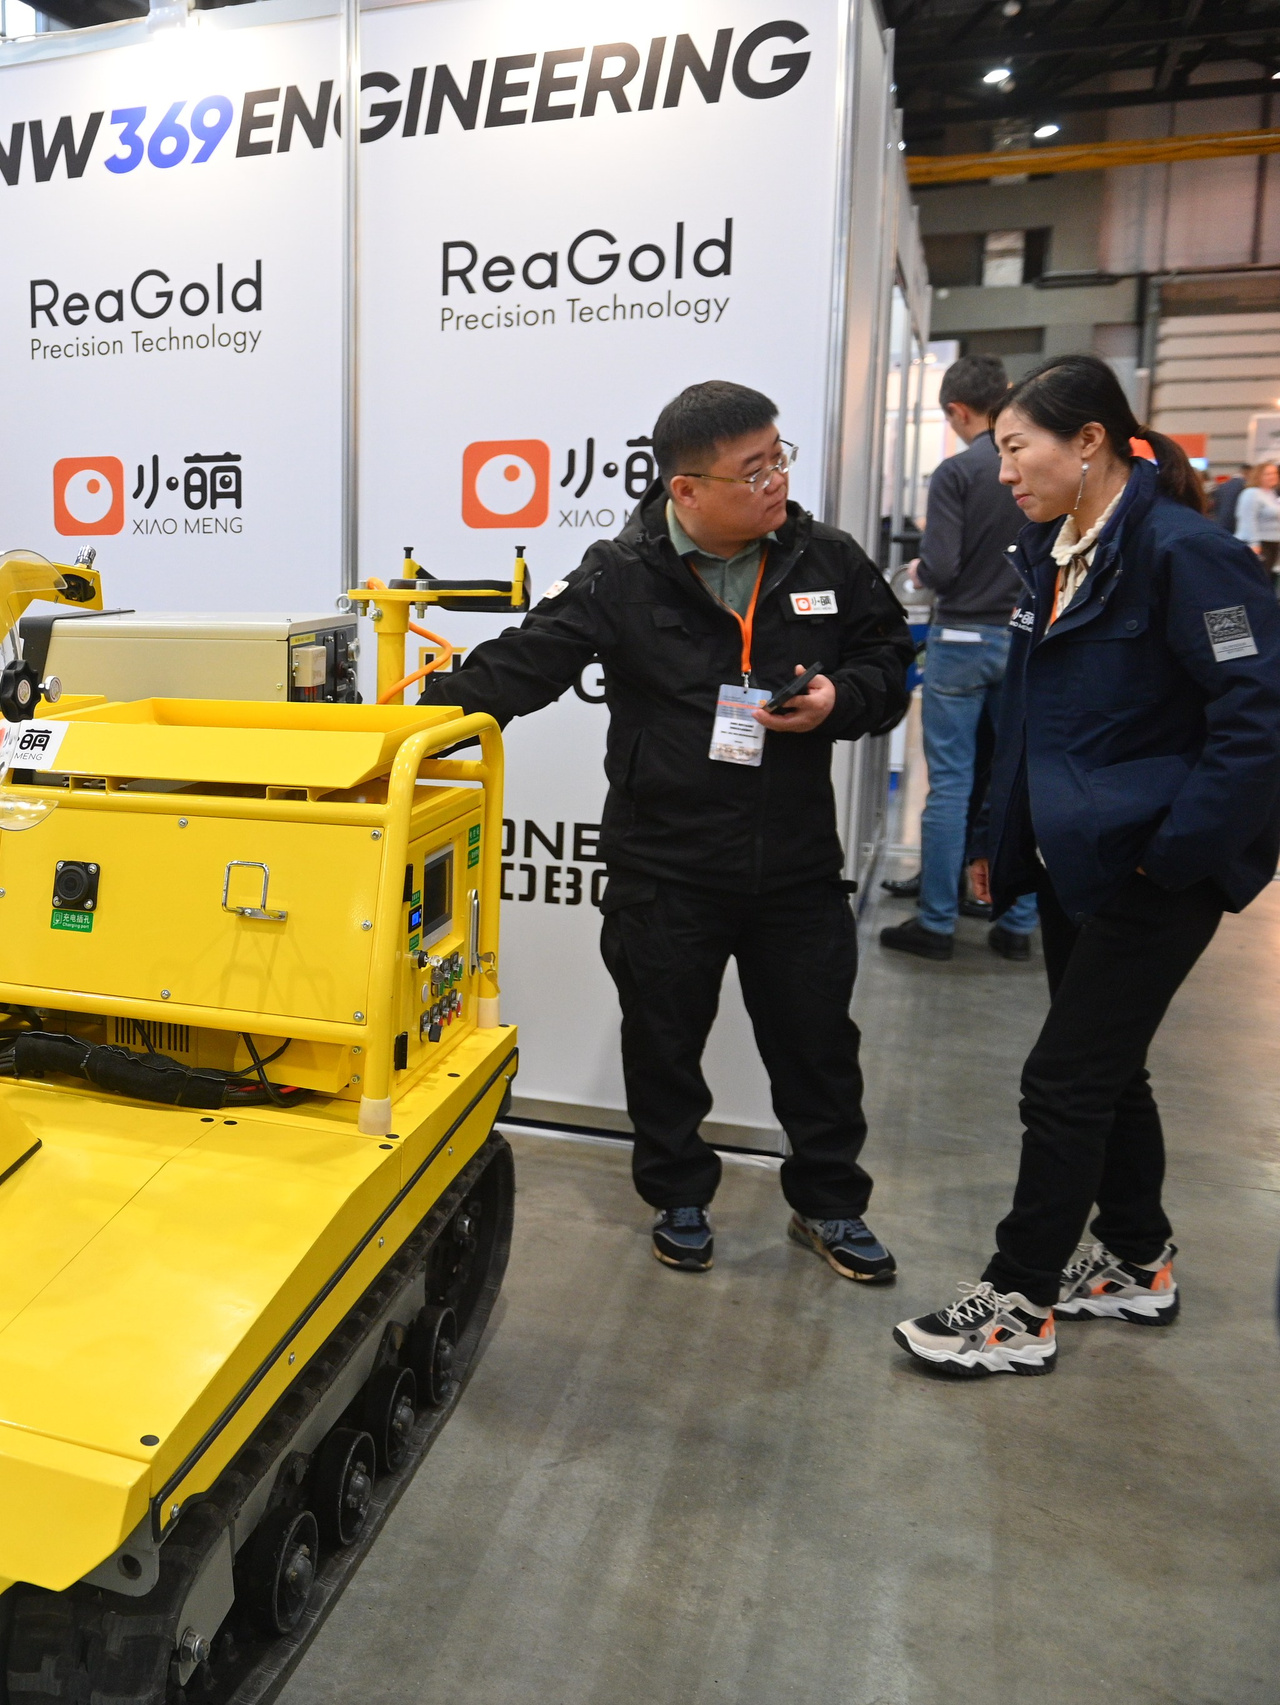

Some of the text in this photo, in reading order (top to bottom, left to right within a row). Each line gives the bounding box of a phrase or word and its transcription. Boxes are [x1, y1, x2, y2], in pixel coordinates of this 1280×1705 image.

[442, 217, 733, 296] ReaGold
[30, 259, 262, 329] ReaGold
[441, 290, 731, 332] Precision Technology
[31, 323, 262, 360] Precision Technology
[132, 451, 242, 511] 小萌
[132, 516, 243, 535] XIAO MENG
[558, 508, 615, 528] XIAO
[14, 752, 44, 761] MENG
